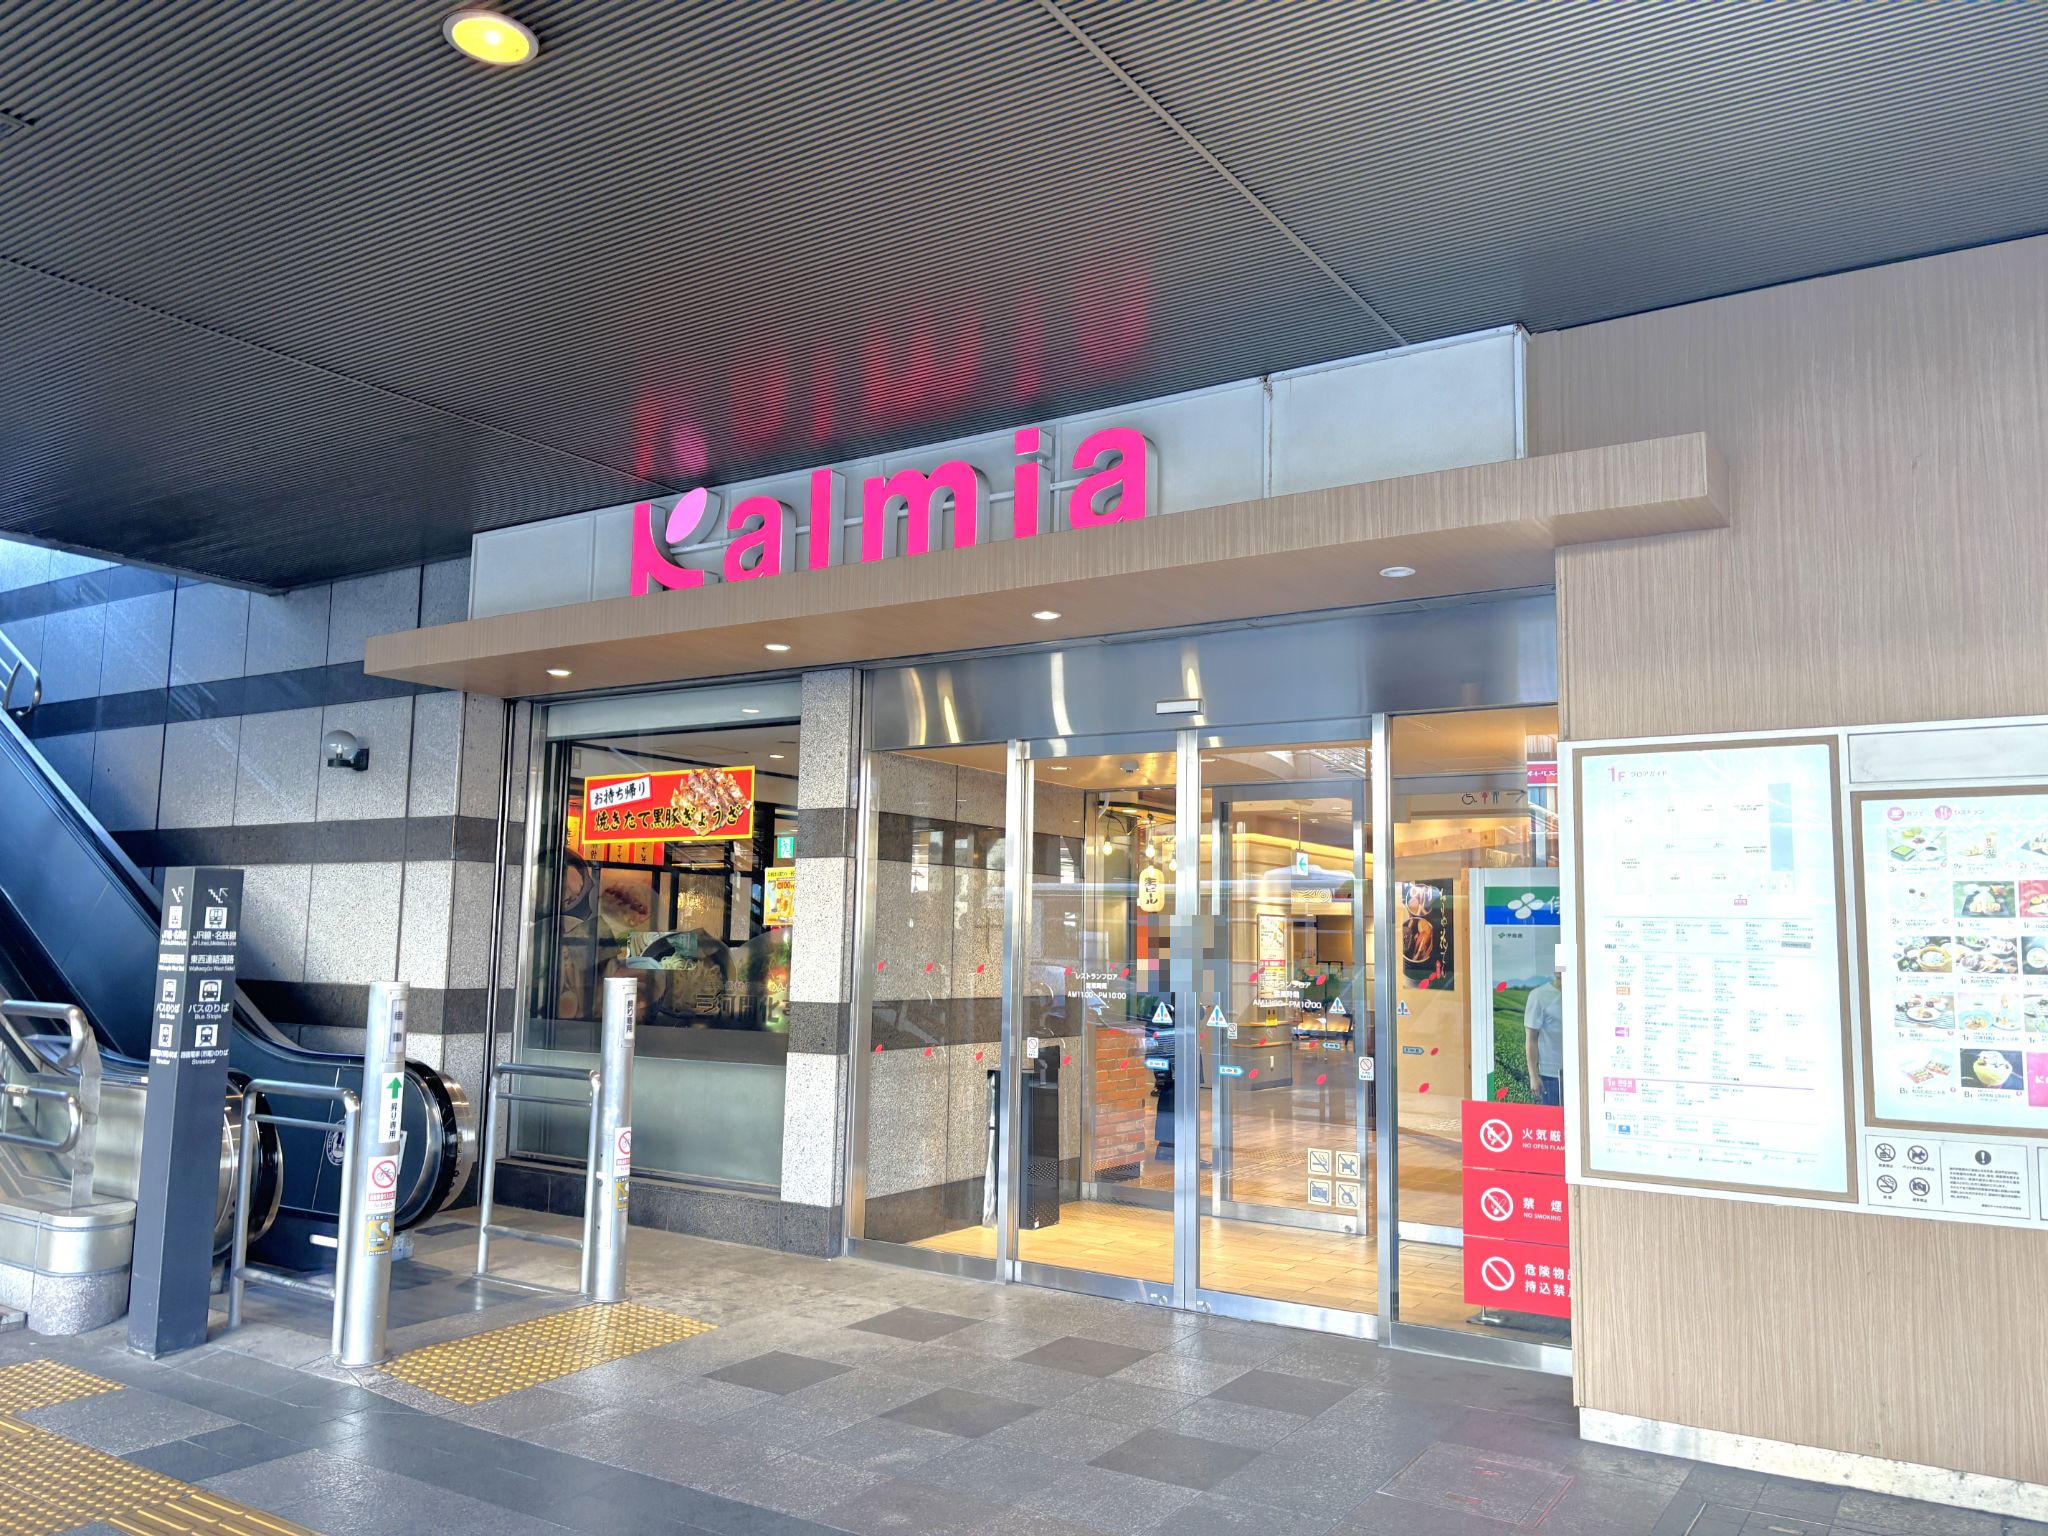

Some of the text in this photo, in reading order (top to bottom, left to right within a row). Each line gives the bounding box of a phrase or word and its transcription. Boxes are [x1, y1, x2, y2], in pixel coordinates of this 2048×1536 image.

[630, 426, 1152, 597] Kalmia
[1608, 766, 1626, 782] 1F
[594, 781, 646, 806] お持ち帰り
[594, 804, 743, 832] 焼きたて黒豚ぎょうざ
[1145, 877, 1159, 905] 生ビール
[1075, 973, 1118, 981] レストランフロア
[188, 1002, 230, 1014] バスのりば
[388, 1102, 398, 1140] 昇り専用
[1523, 1212, 1562, 1222] NO SMOKING
